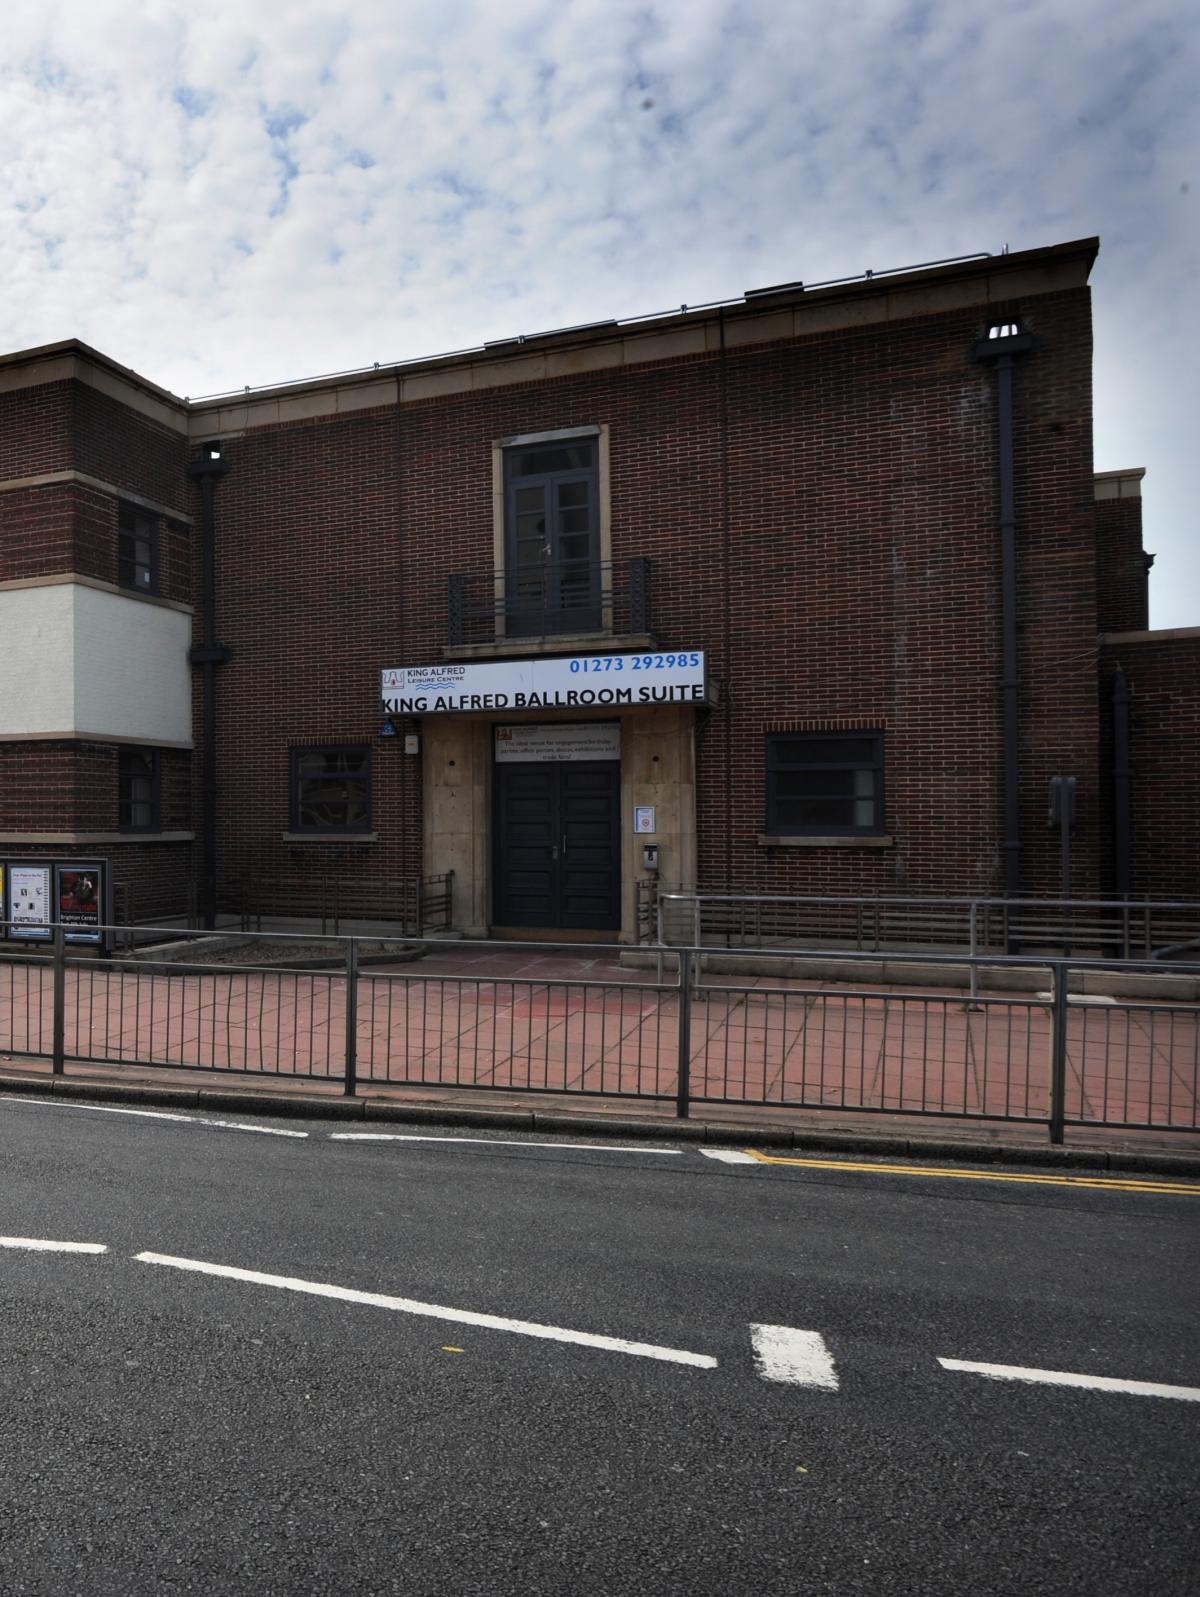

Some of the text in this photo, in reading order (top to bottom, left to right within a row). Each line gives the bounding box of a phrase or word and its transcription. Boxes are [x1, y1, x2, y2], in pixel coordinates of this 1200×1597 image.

[570, 653, 700, 673] 01273 292985
[407, 667, 466, 677] KING ALFRED
[381, 684, 704, 713] KING ALFRED BALLROOM SUITE
[60, 914, 80, 923] Brighton
